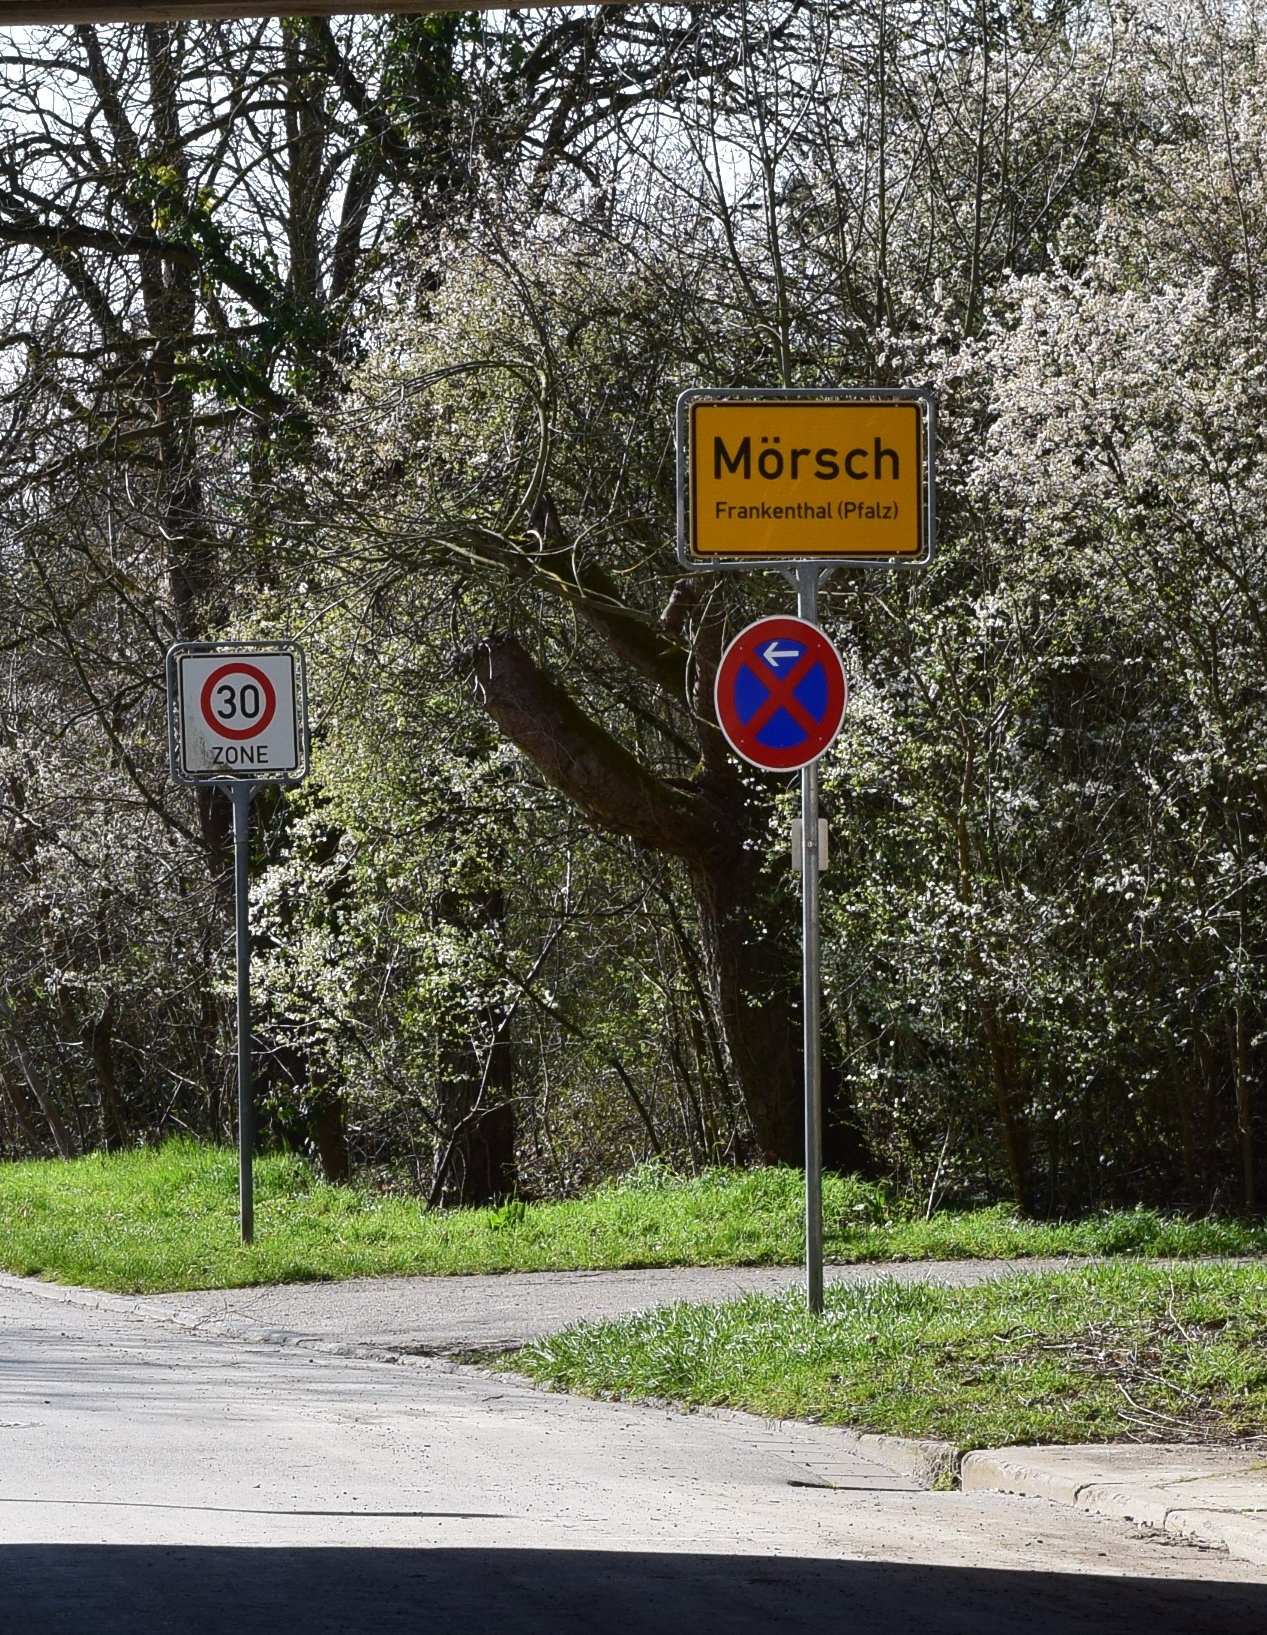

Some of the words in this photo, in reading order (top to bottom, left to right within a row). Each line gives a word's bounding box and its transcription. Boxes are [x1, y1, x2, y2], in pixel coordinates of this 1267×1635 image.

[713, 436, 899, 479] Mörsch
[715, 501, 832, 519] Frankenthal
[837, 500, 898, 519] (Pfalz)
[216, 684, 259, 718] 30
[212, 745, 268, 764] ZONE
